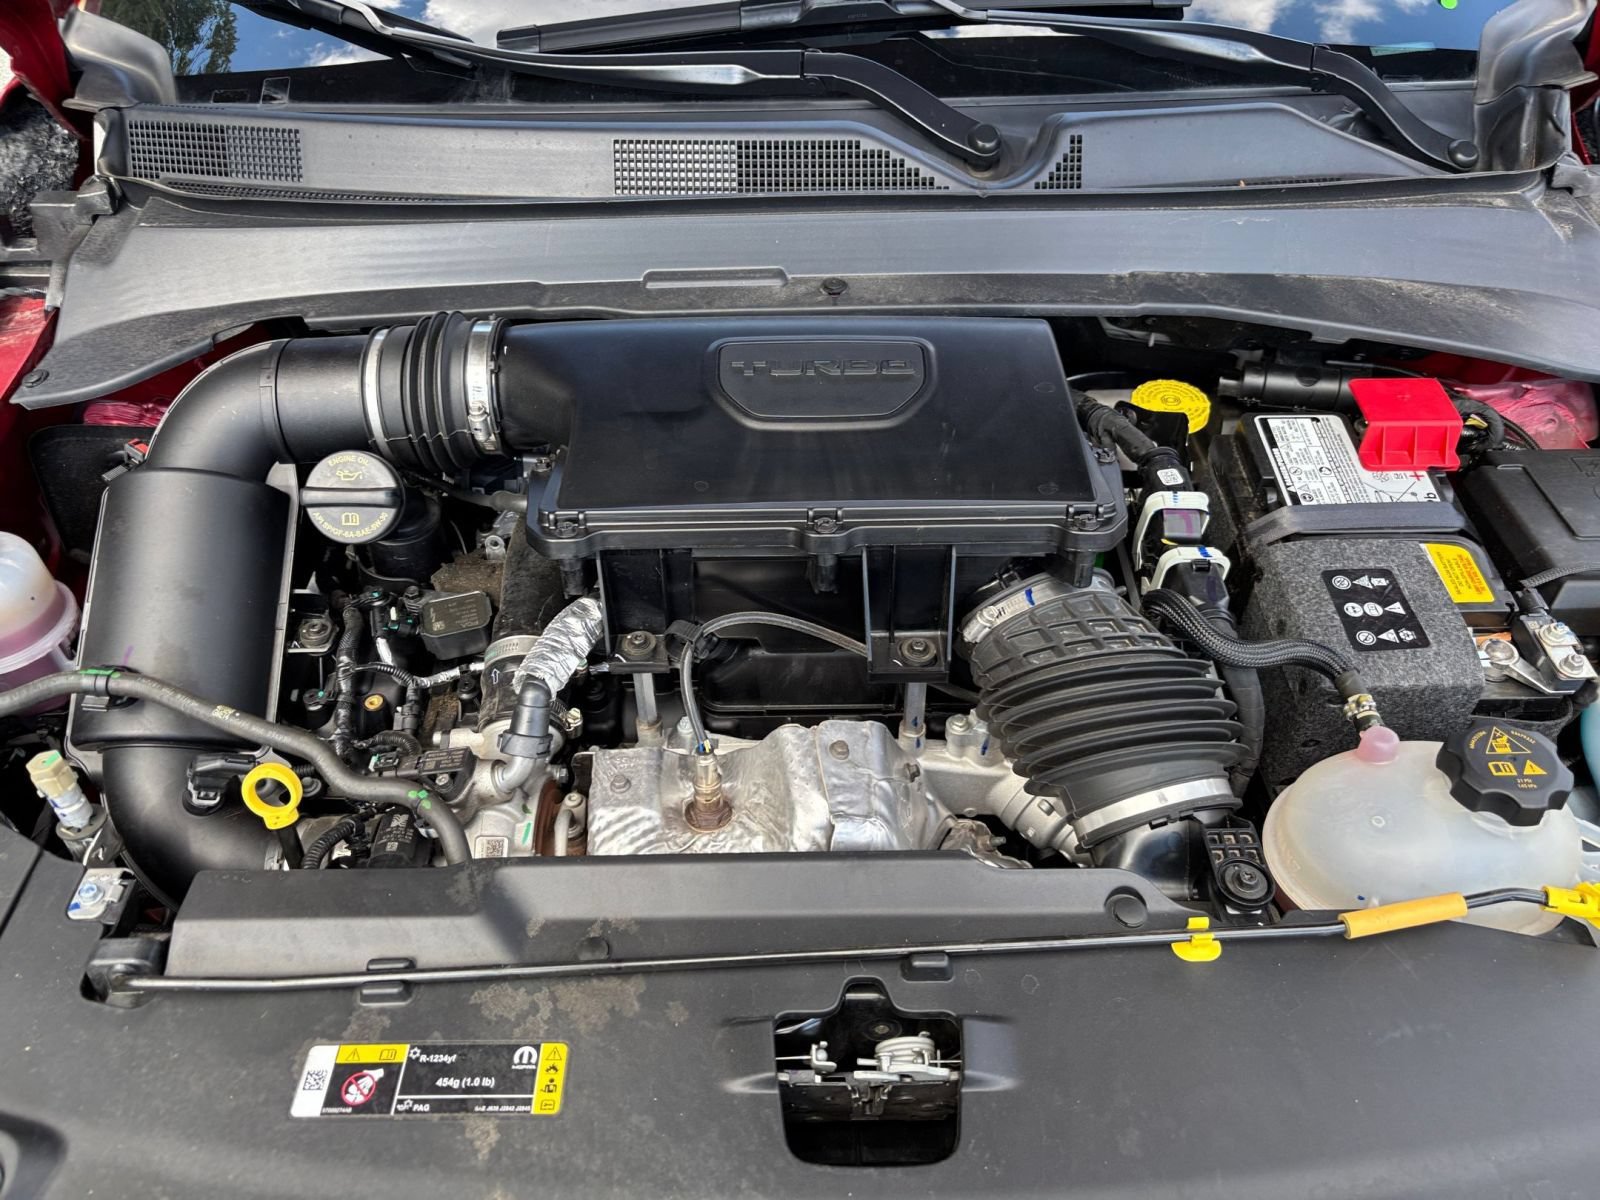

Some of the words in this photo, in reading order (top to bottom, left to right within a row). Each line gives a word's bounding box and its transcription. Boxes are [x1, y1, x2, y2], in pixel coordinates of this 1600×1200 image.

[732, 360, 916, 376] TURBO
[328, 455, 357, 466] ENGINE
[358, 456, 370, 466] OIL
[312, 512, 324, 524] API
[419, 1054, 458, 1064] R-1234yf
[435, 1077, 459, 1089] 454g
[462, 1076, 480, 1088] (1.0
[481, 1076, 495, 1087] lb)
